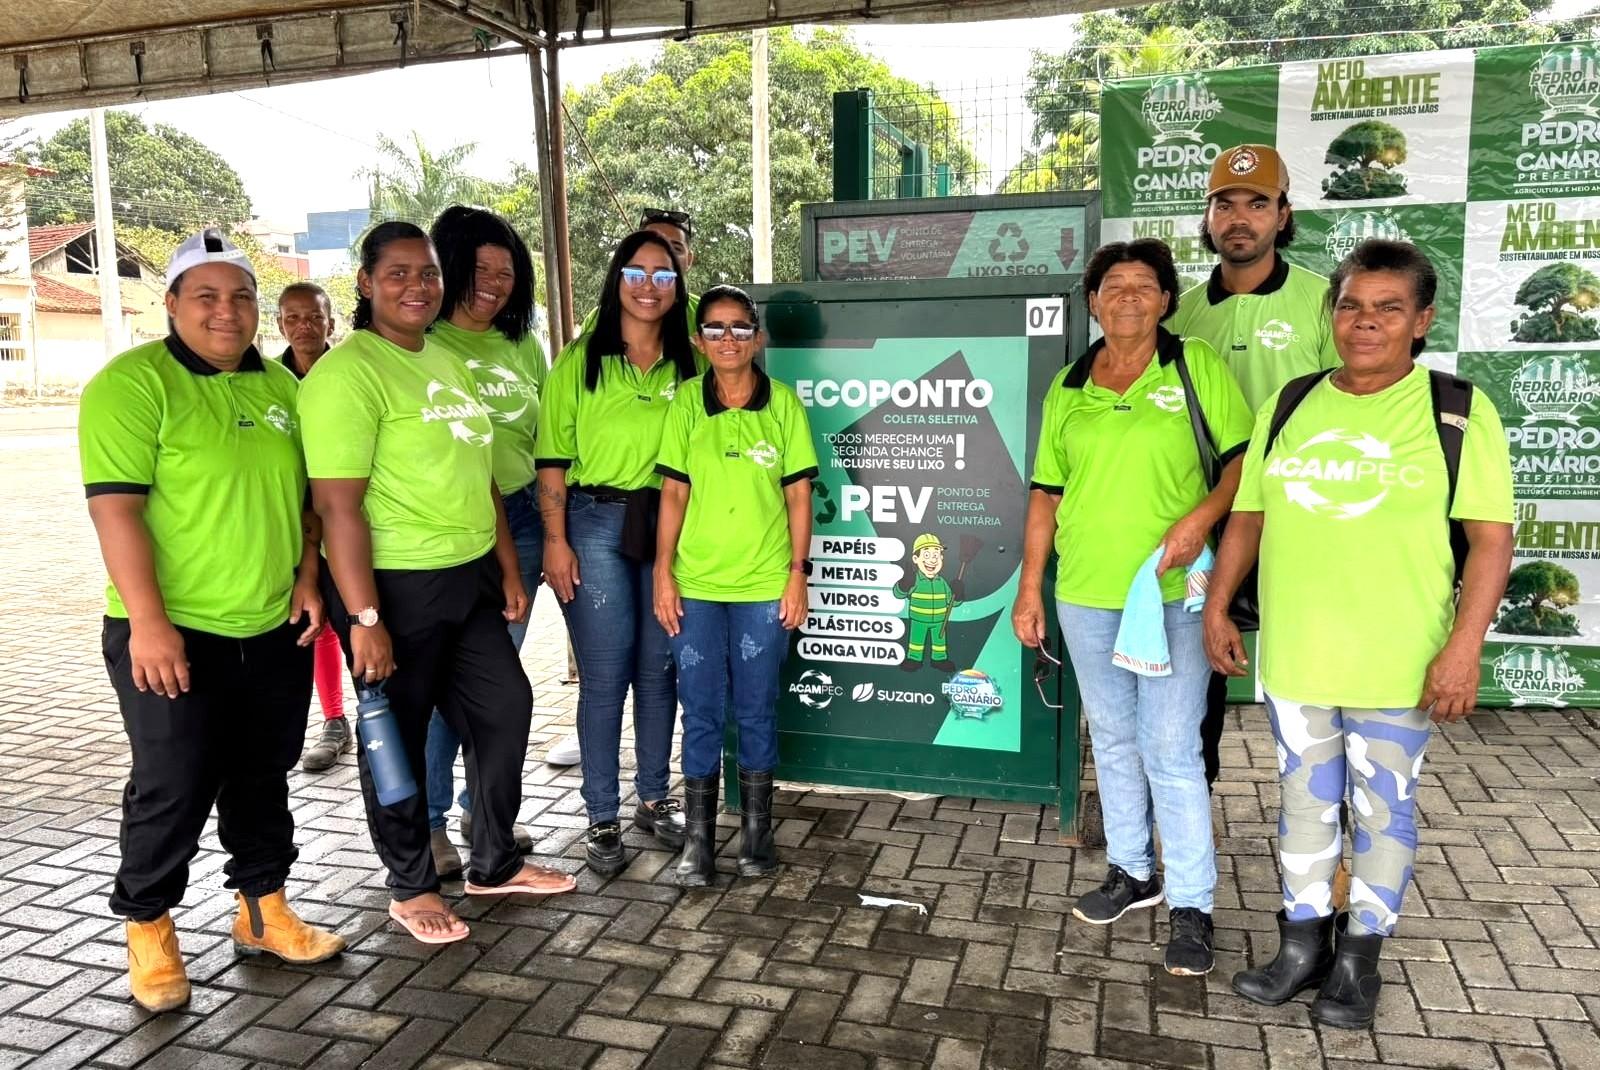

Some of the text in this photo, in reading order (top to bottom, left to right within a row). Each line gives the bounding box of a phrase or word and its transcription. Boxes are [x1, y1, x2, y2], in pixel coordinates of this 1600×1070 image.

[1318, 60, 1364, 81] MEIO
[1531, 71, 1582, 85] PEDRO
[1311, 73, 1440, 111] AMBIENTE
[1546, 79, 1600, 96] CANÁR
[1143, 100, 1187, 113] PEDRO
[1311, 109, 1375, 121] SUSTENTABILIDADE
[1376, 108, 1387, 116] EM
[1389, 106, 1417, 116] NOSSAS
[1521, 119, 1600, 146] PEDR
[1137, 143, 1222, 168] PEDRO
[1515, 144, 1600, 171] CANÁR
[1507, 203, 1556, 222] MEIO
[1133, 219, 1175, 239] MEIO
[1500, 220, 1600, 251] AMBIEN
[824, 228, 897, 263] PEV
[1499, 252, 1568, 262] SUSTENTABILIDADE
[1570, 251, 1580, 259] EM
[968, 266, 1002, 276] LIXO
[1029, 306, 1060, 328] 07
[796, 379, 993, 408] ECOPONTO
[1512, 381, 1562, 392] PEDRO
[883, 414, 978, 425] COLETA SELETIVA
[822, 433, 954, 445] TODOS MERECEM UMA
[1505, 427, 1600, 449] PEDRO
[832, 446, 943, 458] SEGUNDA CHANCE
[831, 458, 945, 470] INCLUSIVE SEU LIXO
[1264, 457, 1425, 488] ACAMPEC
[937, 487, 990, 497] PONTO DE
[841, 485, 934, 523] PEV
[937, 502, 985, 511] ENTREGA
[937, 515, 1001, 526] VOLUNTÁRIA
[823, 539, 876, 554] PAPÉIS
[1549, 550, 1559, 558] EM
[1562, 551, 1590, 559] NOSSAS
[822, 567, 878, 581] METAIS
[820, 593, 879, 607] VIDROS
[808, 615, 893, 633] PLÁSTICOS
[803, 643, 898, 660] LONGA VIDA
[1496, 669, 1544, 680] PEDRO
[789, 683, 843, 696] ACAMPEC
[944, 684, 978, 695] PEDRO
[1512, 679, 1576, 691] CANÁRIO
[877, 689, 935, 704] suzano
[953, 693, 1001, 705] CANÁRIO
